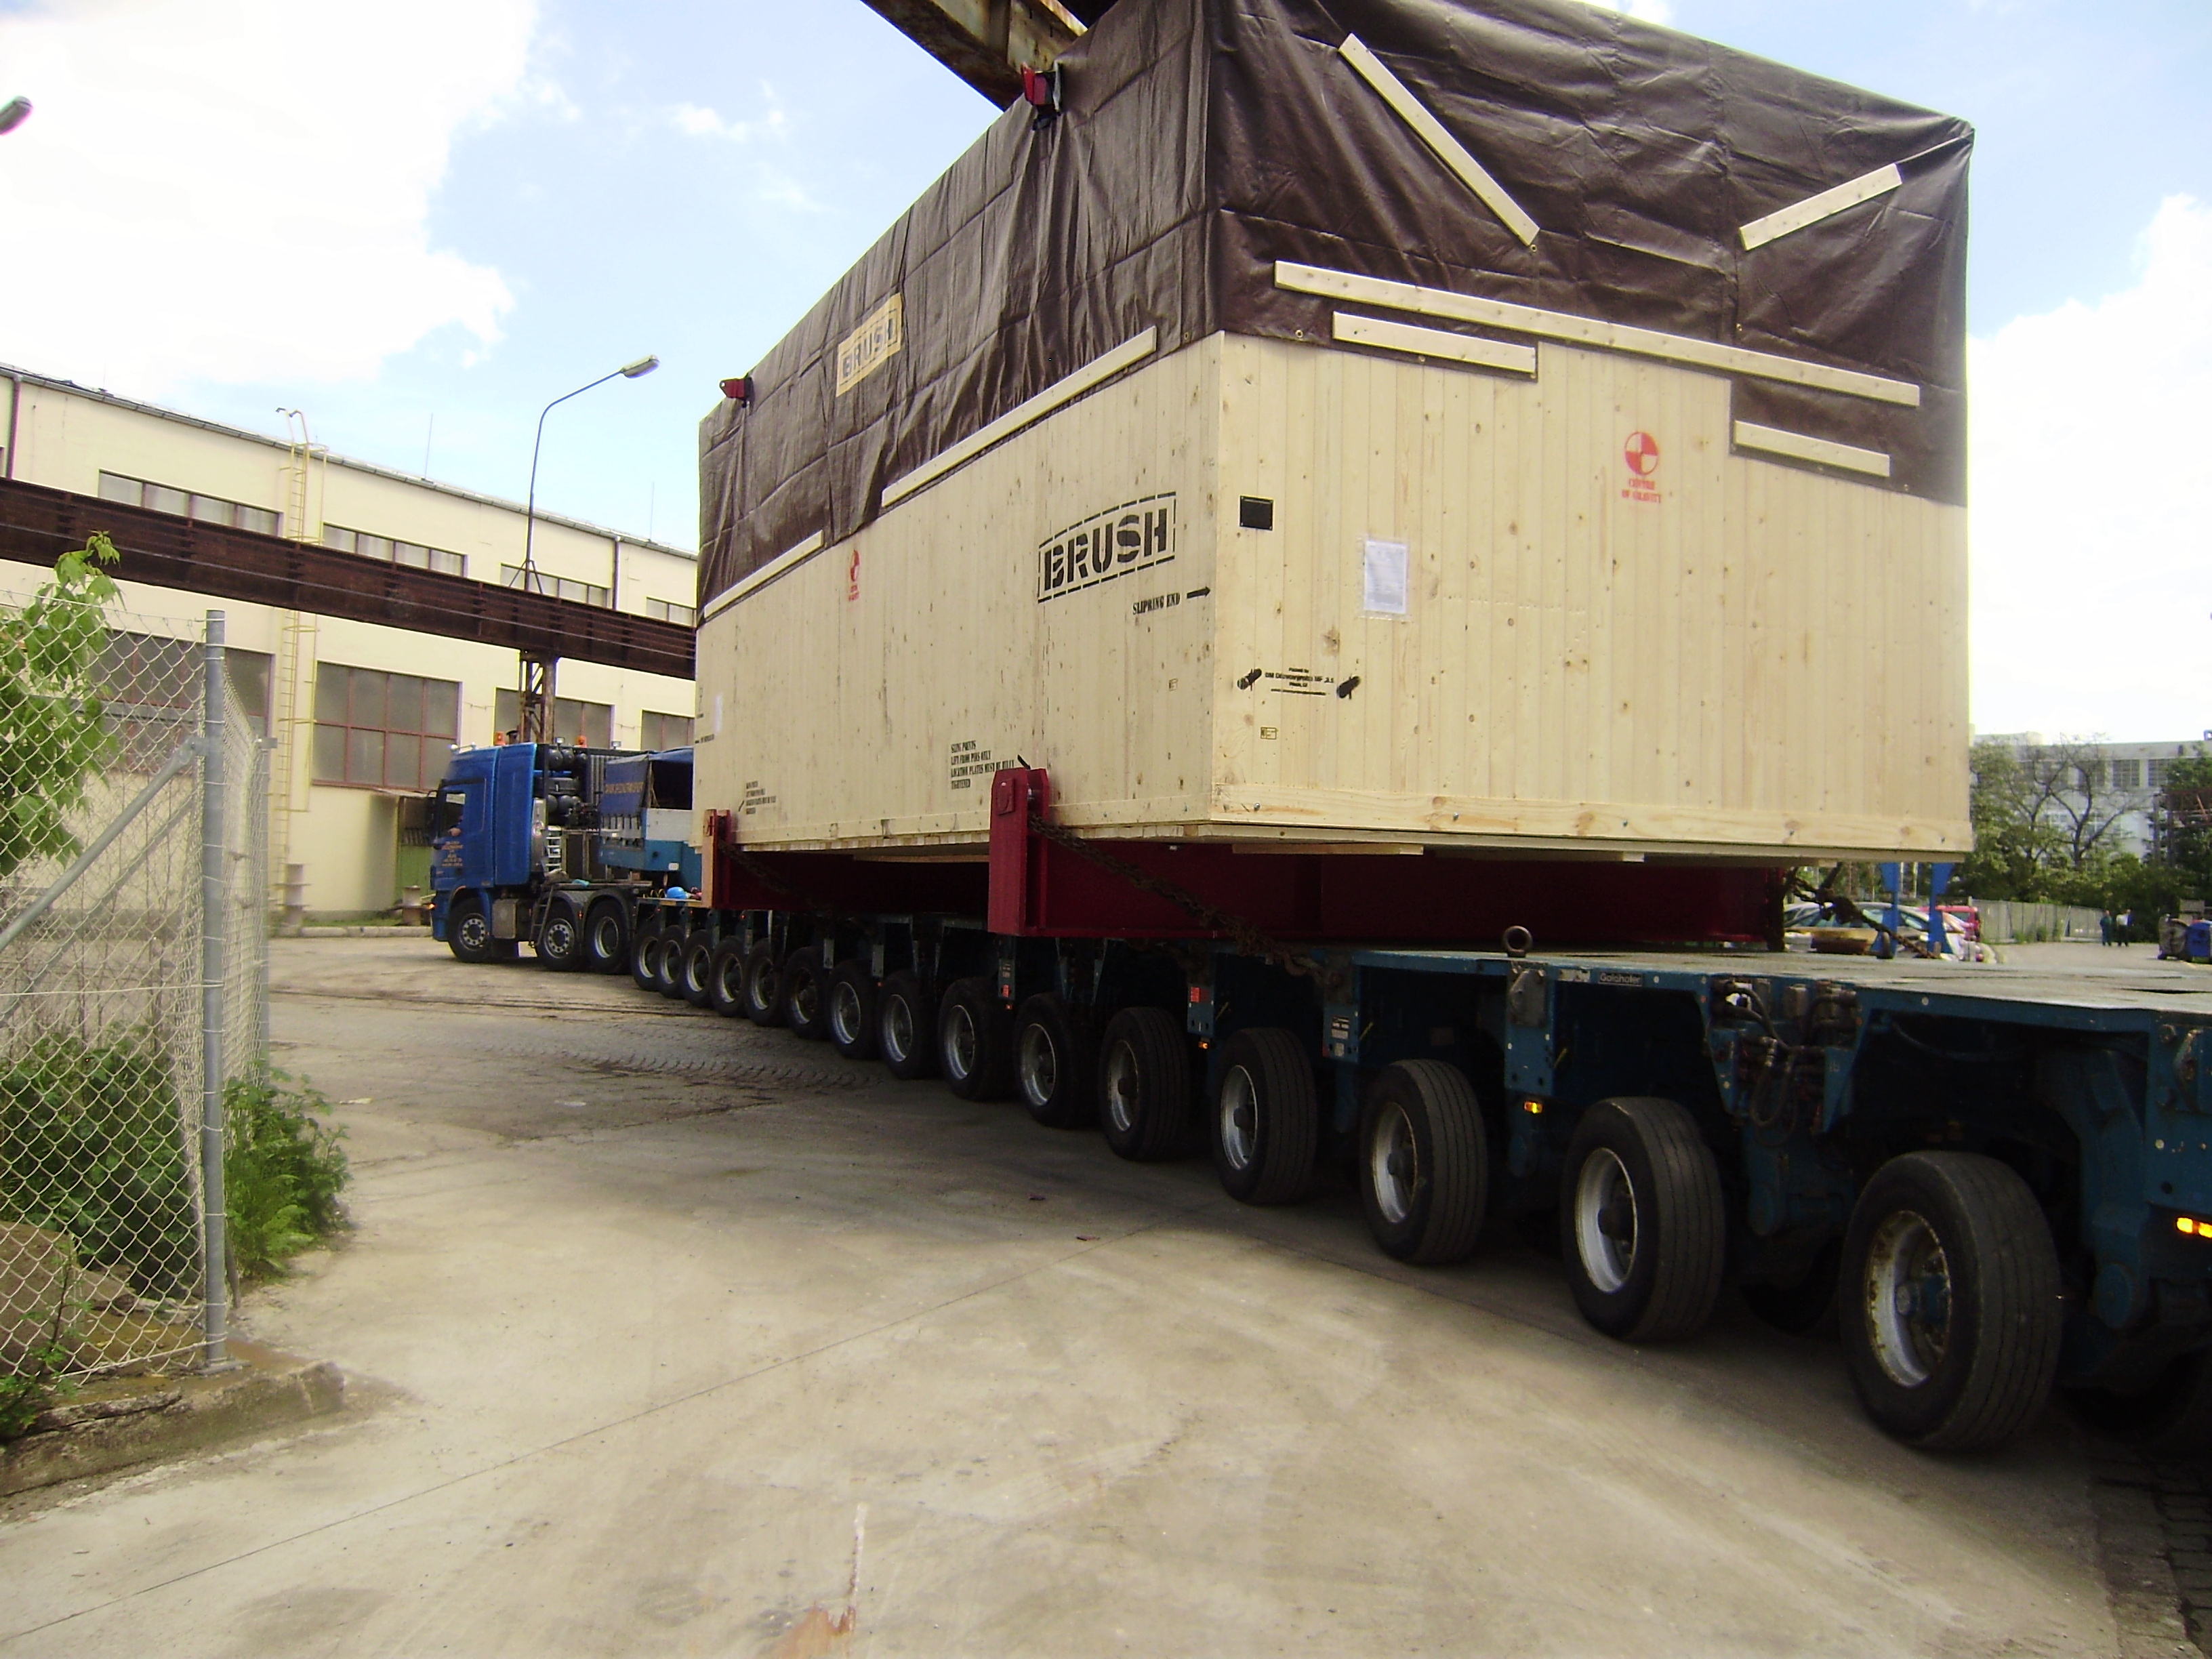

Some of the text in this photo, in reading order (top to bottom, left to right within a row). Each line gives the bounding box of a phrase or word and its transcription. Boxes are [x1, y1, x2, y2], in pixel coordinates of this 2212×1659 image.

[1044, 508, 1167, 591] BRUSH
[1132, 592, 1181, 615] SLIPRING END
